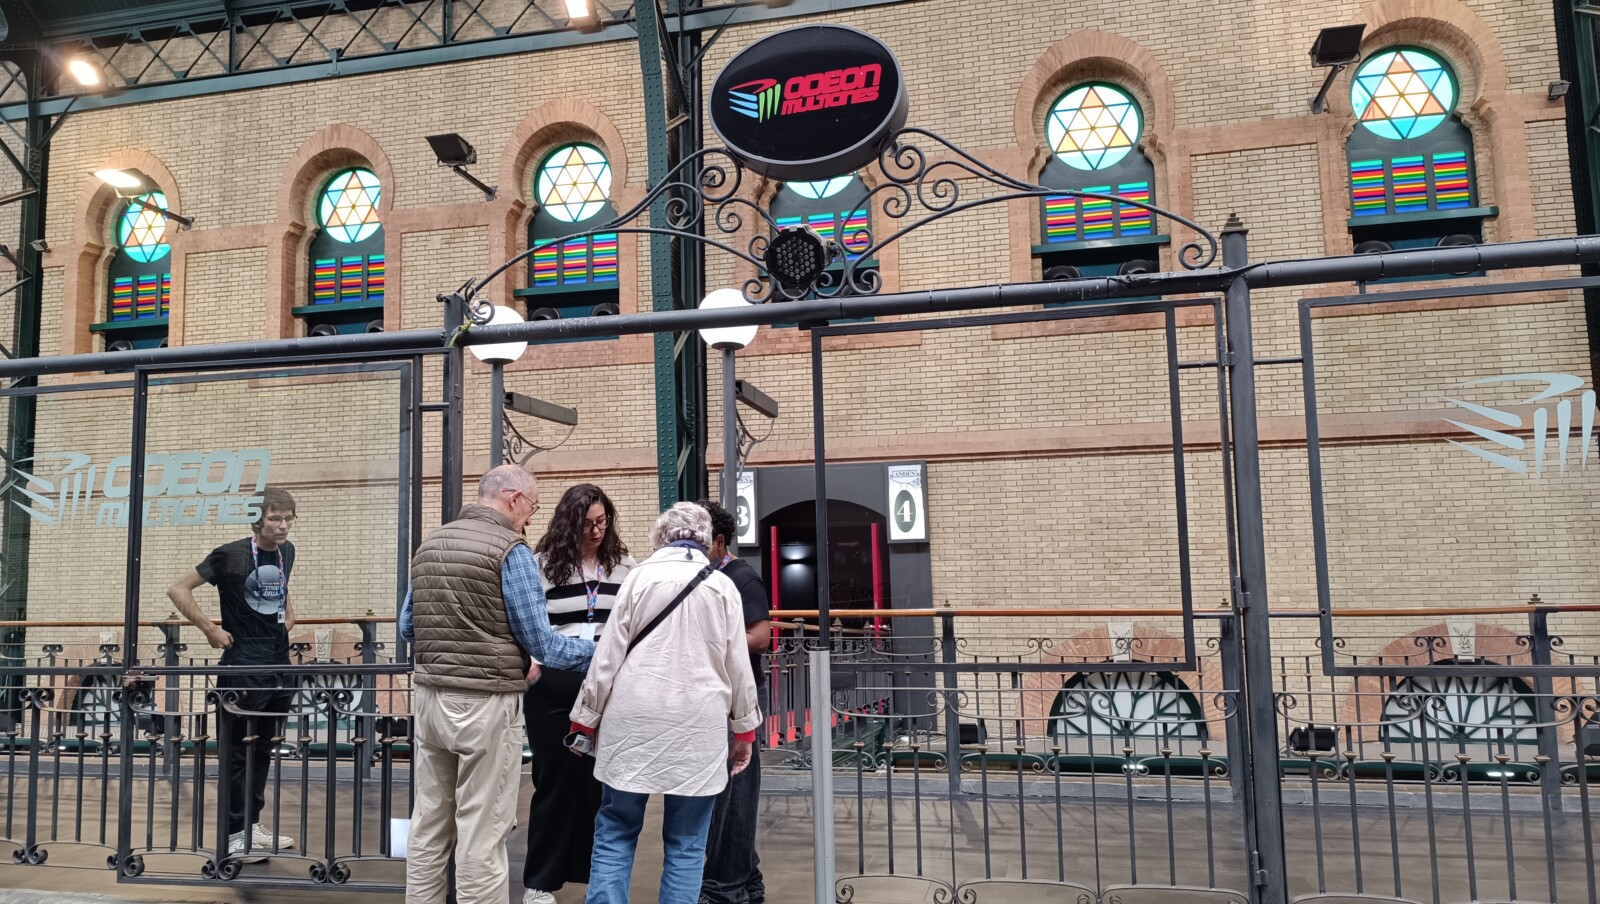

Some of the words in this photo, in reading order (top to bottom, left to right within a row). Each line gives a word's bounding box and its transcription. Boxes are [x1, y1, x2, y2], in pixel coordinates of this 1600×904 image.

[783, 63, 882, 99] ODEON
[102, 447, 271, 498] ODEON
[737, 505, 749, 527] 3
[897, 500, 913, 523] 4
